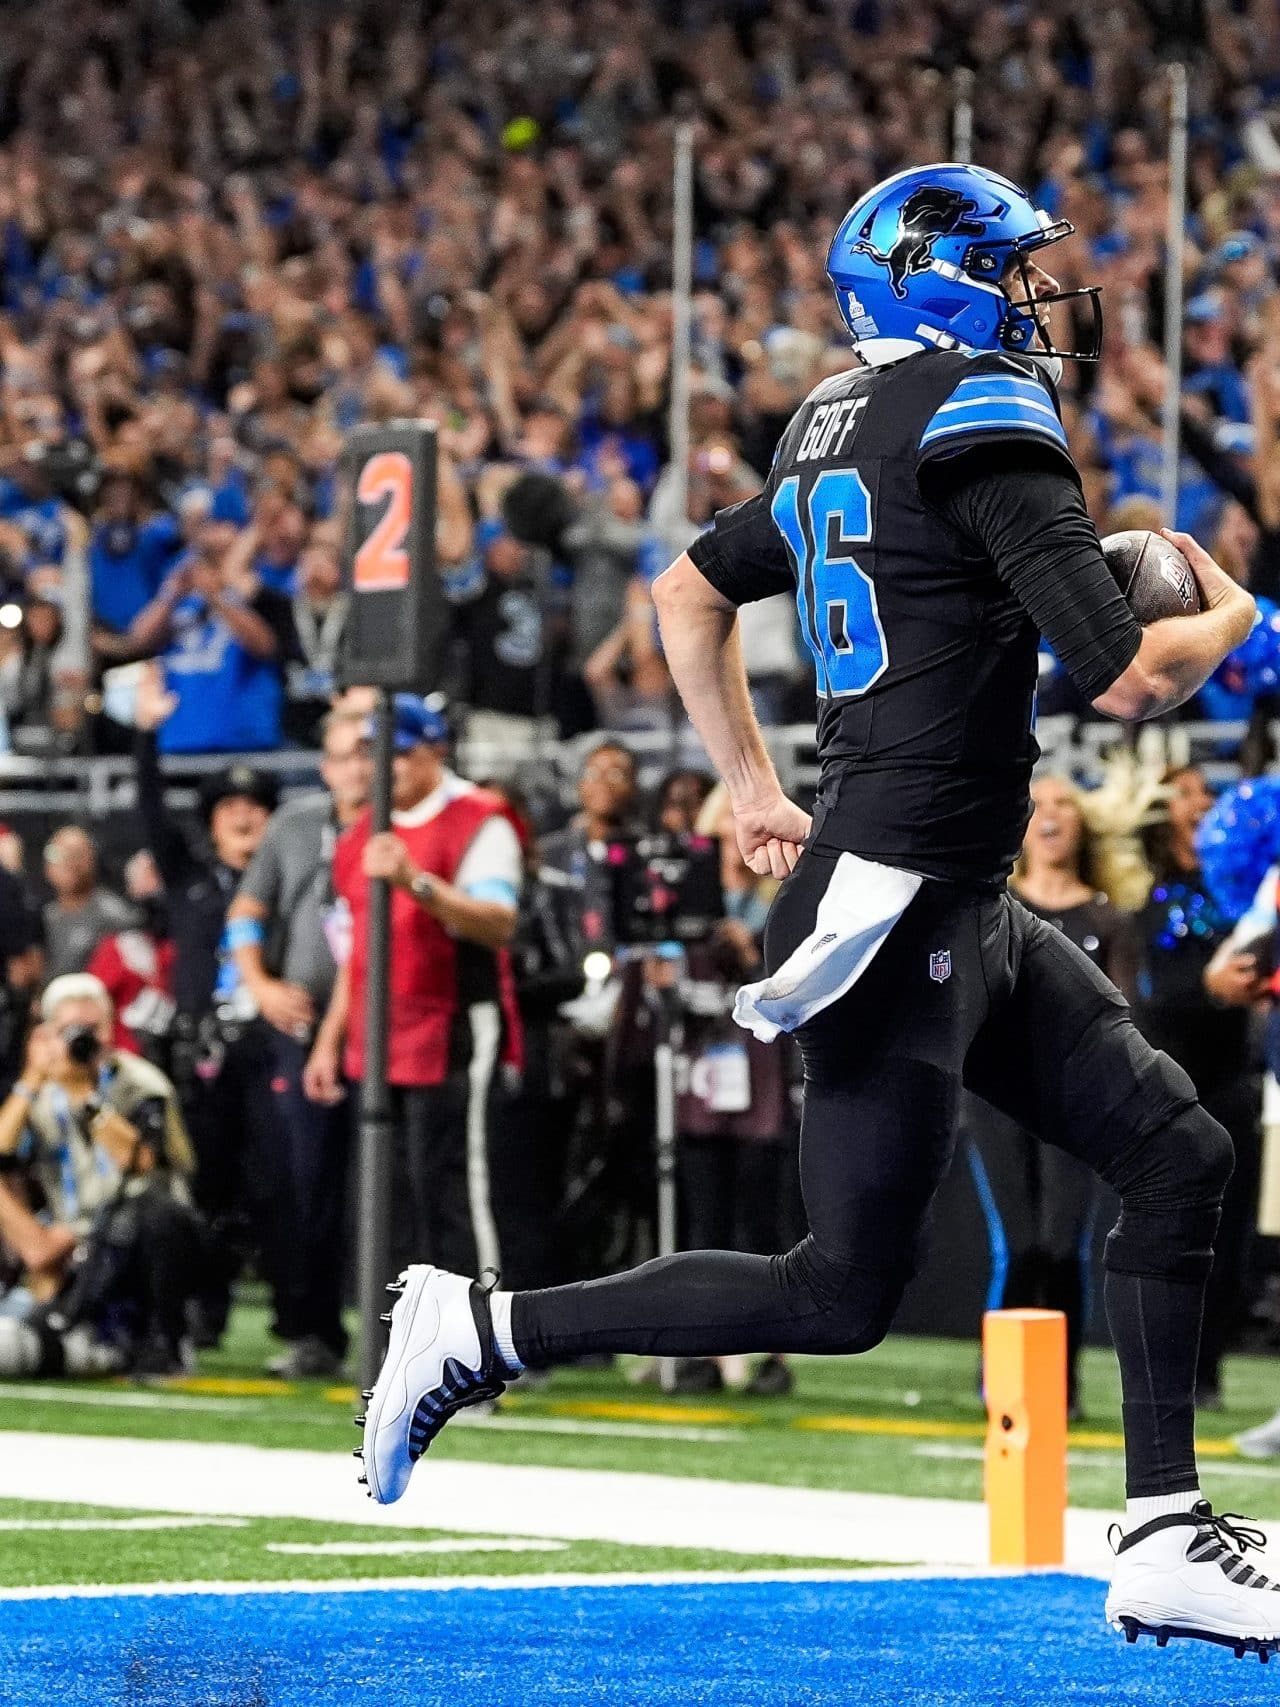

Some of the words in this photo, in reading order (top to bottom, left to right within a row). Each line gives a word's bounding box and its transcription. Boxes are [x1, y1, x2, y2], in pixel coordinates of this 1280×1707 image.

[796, 396, 869, 462] GOFF
[354, 452, 414, 592] 2
[771, 468, 889, 699] 16
